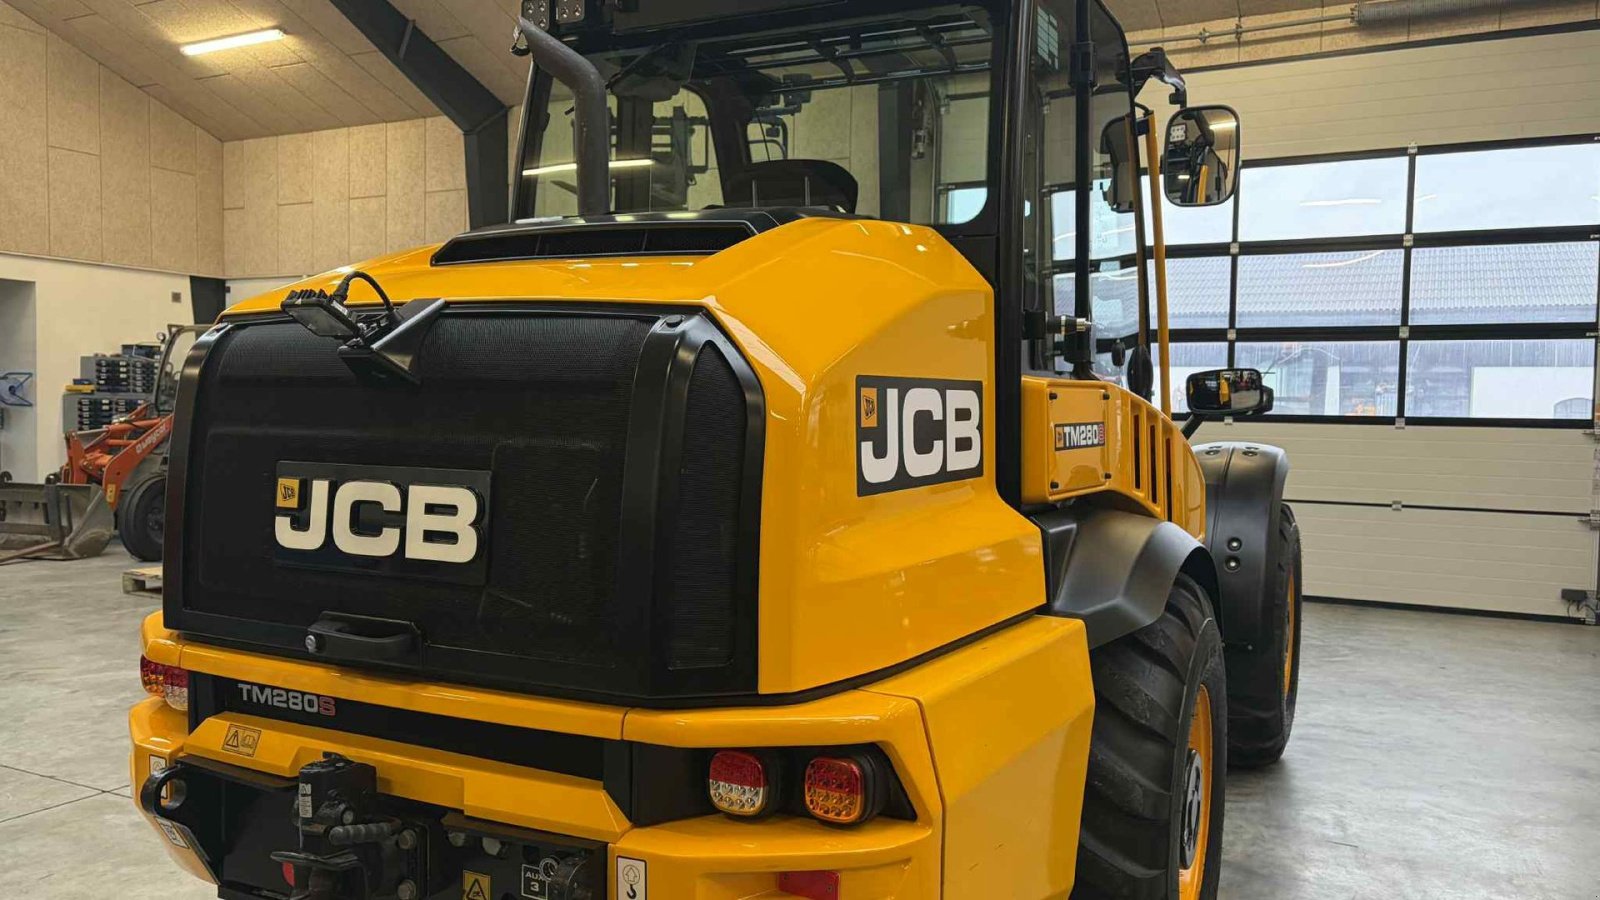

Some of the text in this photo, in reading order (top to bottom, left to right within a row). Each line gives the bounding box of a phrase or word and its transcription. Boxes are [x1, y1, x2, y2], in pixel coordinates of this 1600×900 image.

[861, 387, 981, 484] JCB
[275, 479, 478, 563] JCB
[237, 683, 336, 716] TM280S
[530, 881, 540, 892] 3
